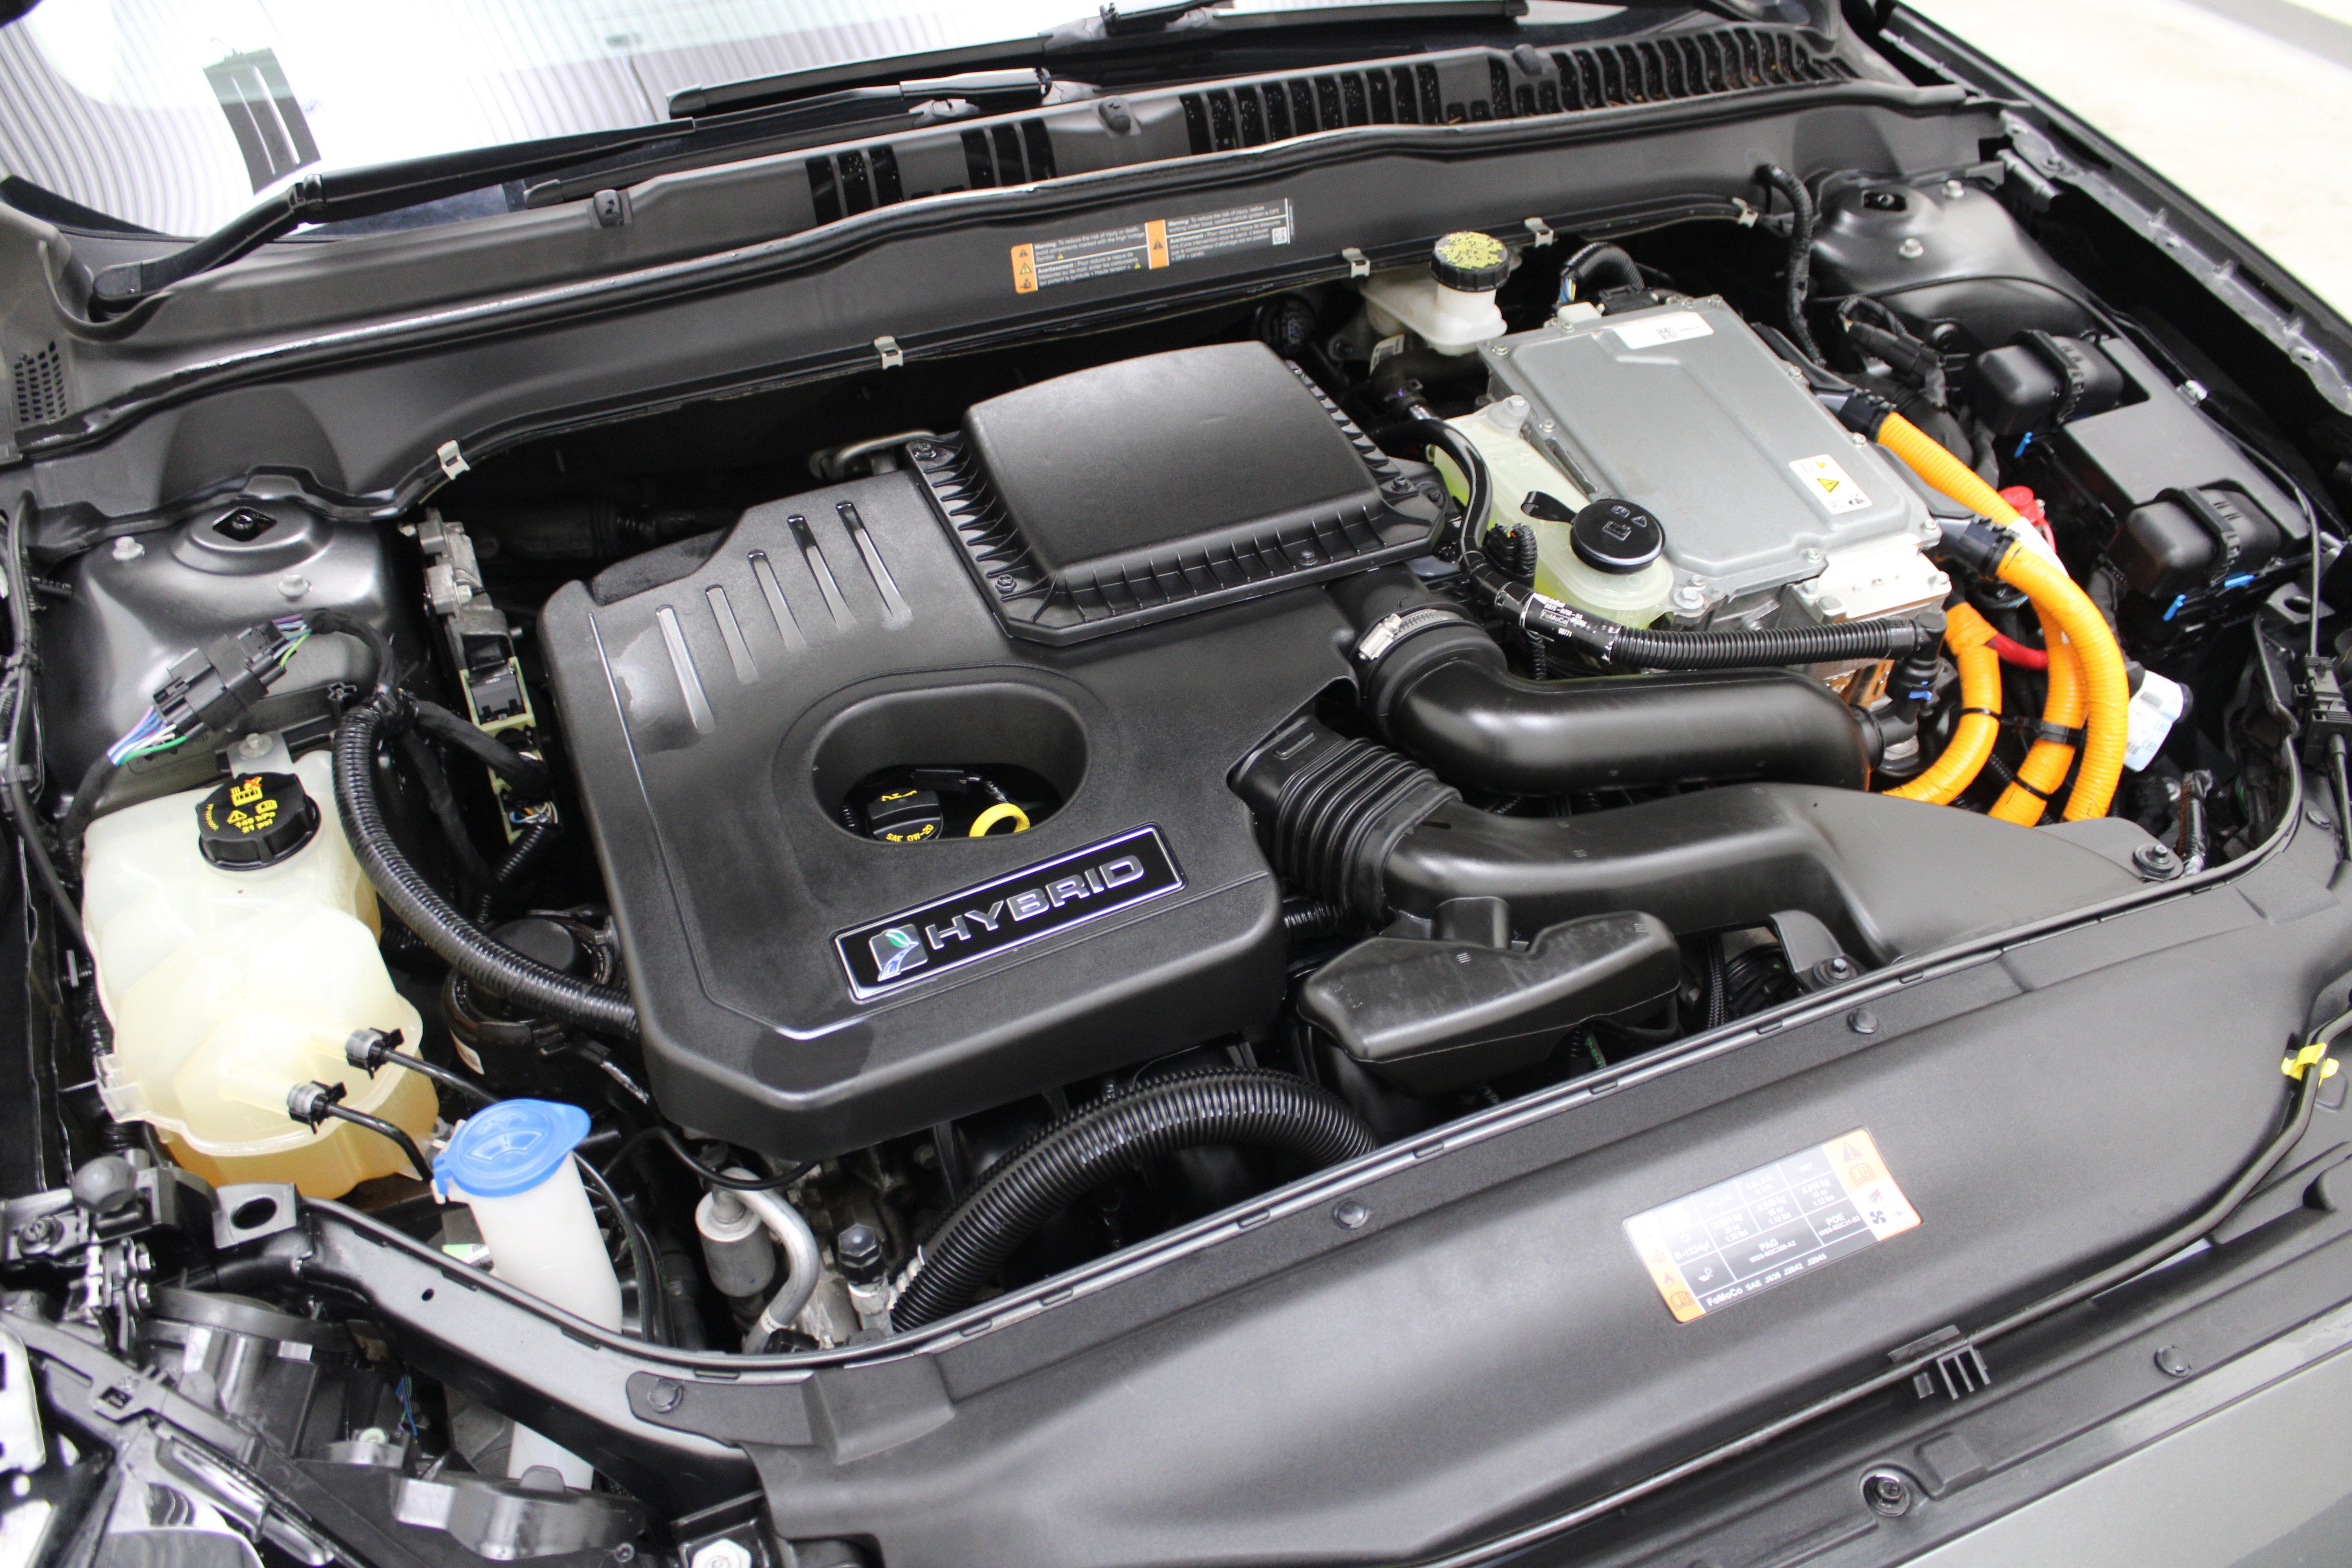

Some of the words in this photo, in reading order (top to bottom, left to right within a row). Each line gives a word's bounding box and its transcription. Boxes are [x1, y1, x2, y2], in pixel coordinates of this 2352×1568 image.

[1541, 612, 1568, 625] FoMoCo
[885, 833, 903, 842] SAE
[924, 855, 1144, 951] HYBRID
[1825, 1212, 1846, 1226] POE
[1674, 1239, 1711, 1261] R-1234yf
[1758, 1238, 1779, 1252] PAG
[1706, 1287, 1743, 1306] FoMoCo
[1745, 1280, 1763, 1291] SAE
[1764, 1272, 1782, 1283] J639
